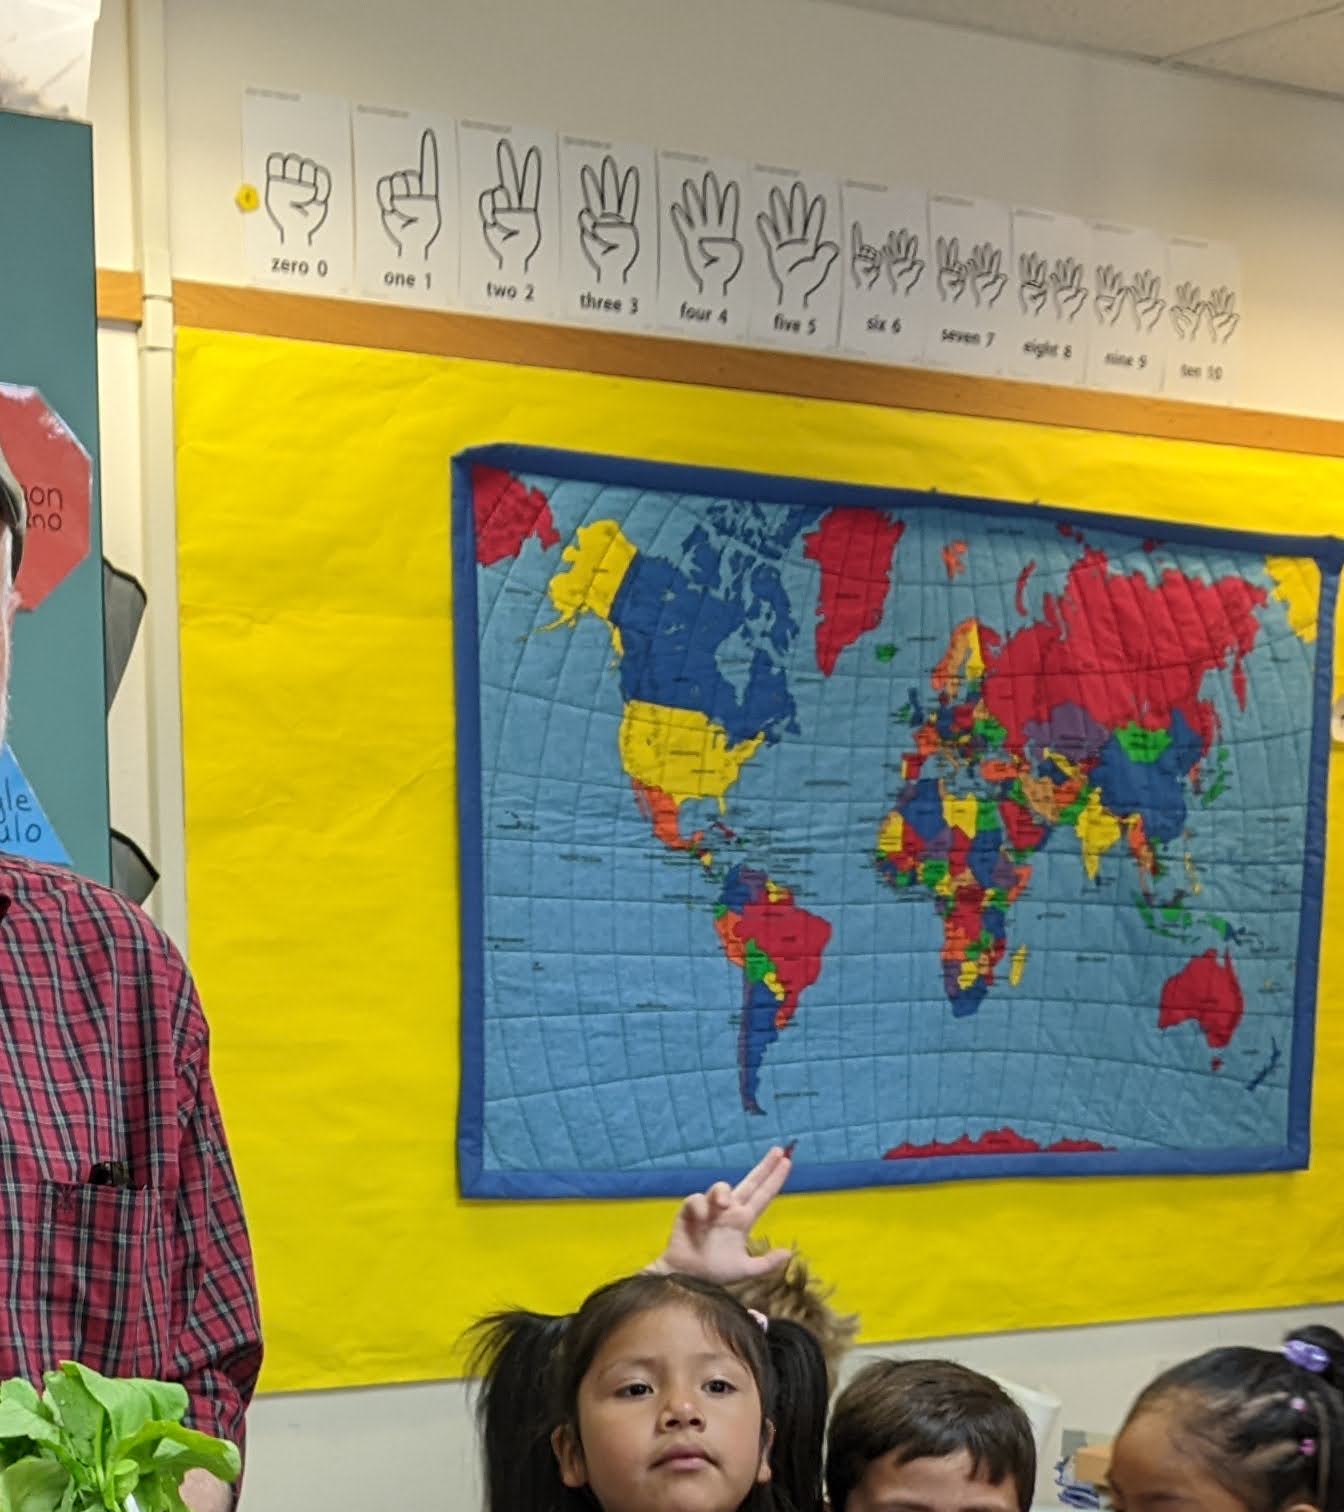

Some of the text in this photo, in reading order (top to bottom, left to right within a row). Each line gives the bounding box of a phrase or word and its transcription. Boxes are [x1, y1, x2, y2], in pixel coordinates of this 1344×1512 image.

[270, 256, 329, 277] zero 0
[383, 270, 432, 289] one 1
[486, 281, 535, 301] two 2
[580, 292, 639, 314] three 3
[679, 301, 728, 324] four 4
[773, 313, 817, 335] five 5
[866, 316, 902, 334] six 6
[942, 327, 995, 347] seven 7
[1023, 340, 1060, 360] eight
